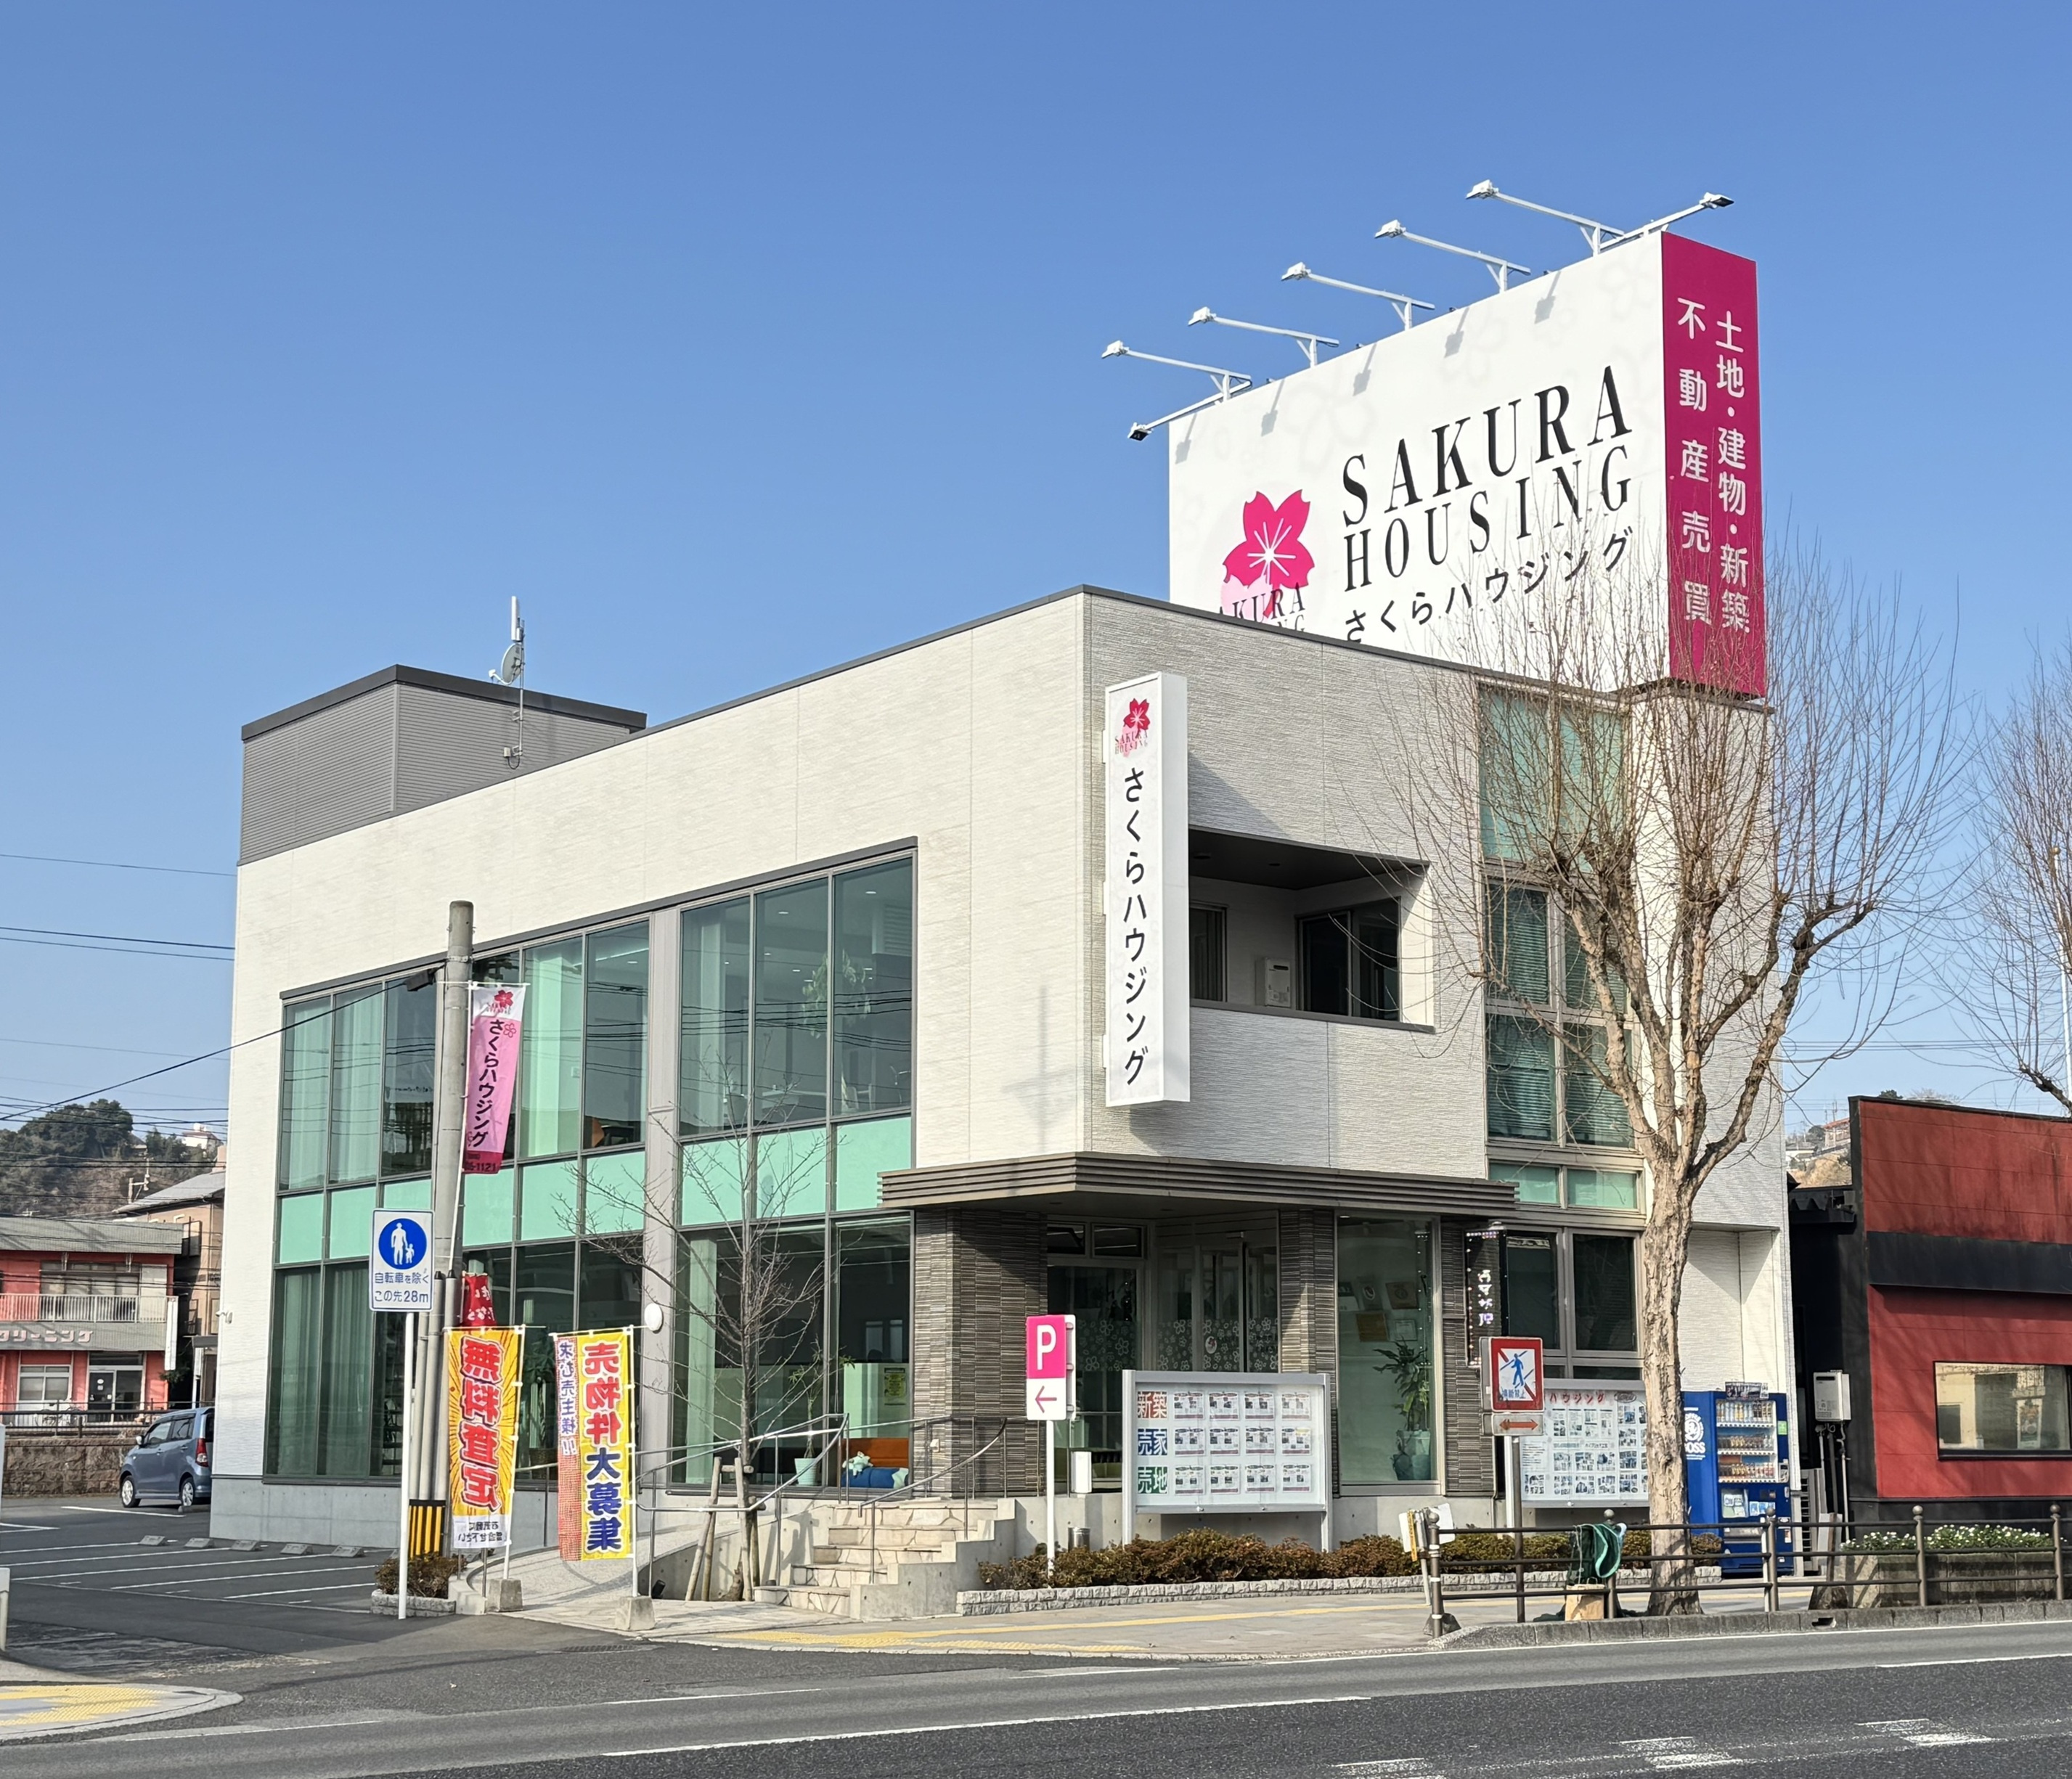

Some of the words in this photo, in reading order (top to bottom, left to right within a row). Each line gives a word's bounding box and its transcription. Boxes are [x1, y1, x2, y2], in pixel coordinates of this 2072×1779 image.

[1342, 365, 1632, 528] SAKURA
[1678, 298, 1711, 626] 不動産売買
[1716, 311, 1750, 633] 土地・建物・新築
[1344, 446, 1631, 592] HOUSING
[1345, 525, 1633, 643] さくらハウジング
[1123, 767, 1149, 1085] さくらハウジング
[472, 1019, 505, 1147] さくらハウジング
[375, 1272, 429, 1284] 自転車を除く
[375, 1290, 429, 1303] この先28m
[1037, 1324, 1057, 1370] P
[1138, 1391, 1167, 1419] 新築
[1138, 1428, 1167, 1455] 売家
[1138, 1466, 1167, 1494] 売地
